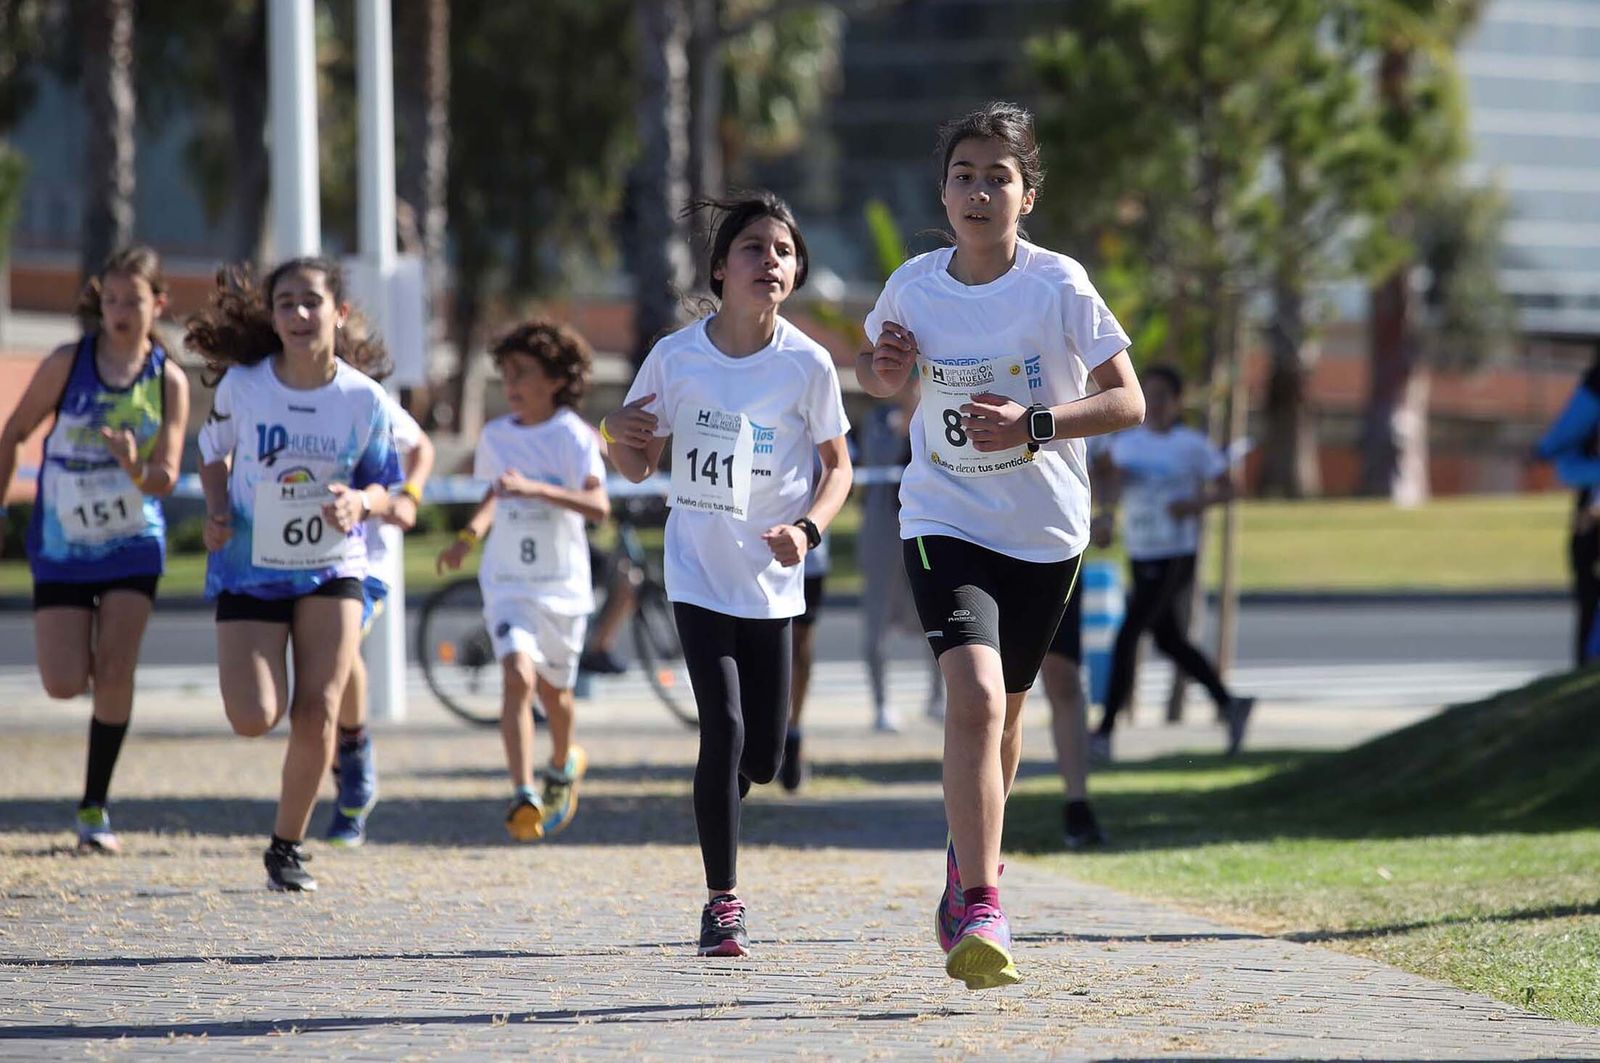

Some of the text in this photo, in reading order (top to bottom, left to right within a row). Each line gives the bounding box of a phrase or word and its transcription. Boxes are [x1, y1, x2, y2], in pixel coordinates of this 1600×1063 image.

[946, 371, 994, 382] DE HUELVA
[288, 433, 336, 454] HUELVA
[686, 448, 735, 489] 141
[978, 464, 993, 473] tus
[73, 497, 127, 528] 151
[677, 496, 697, 507] Huelva
[713, 503, 724, 511] tus
[283, 515, 323, 546] 60
[520, 537, 536, 564] 8
